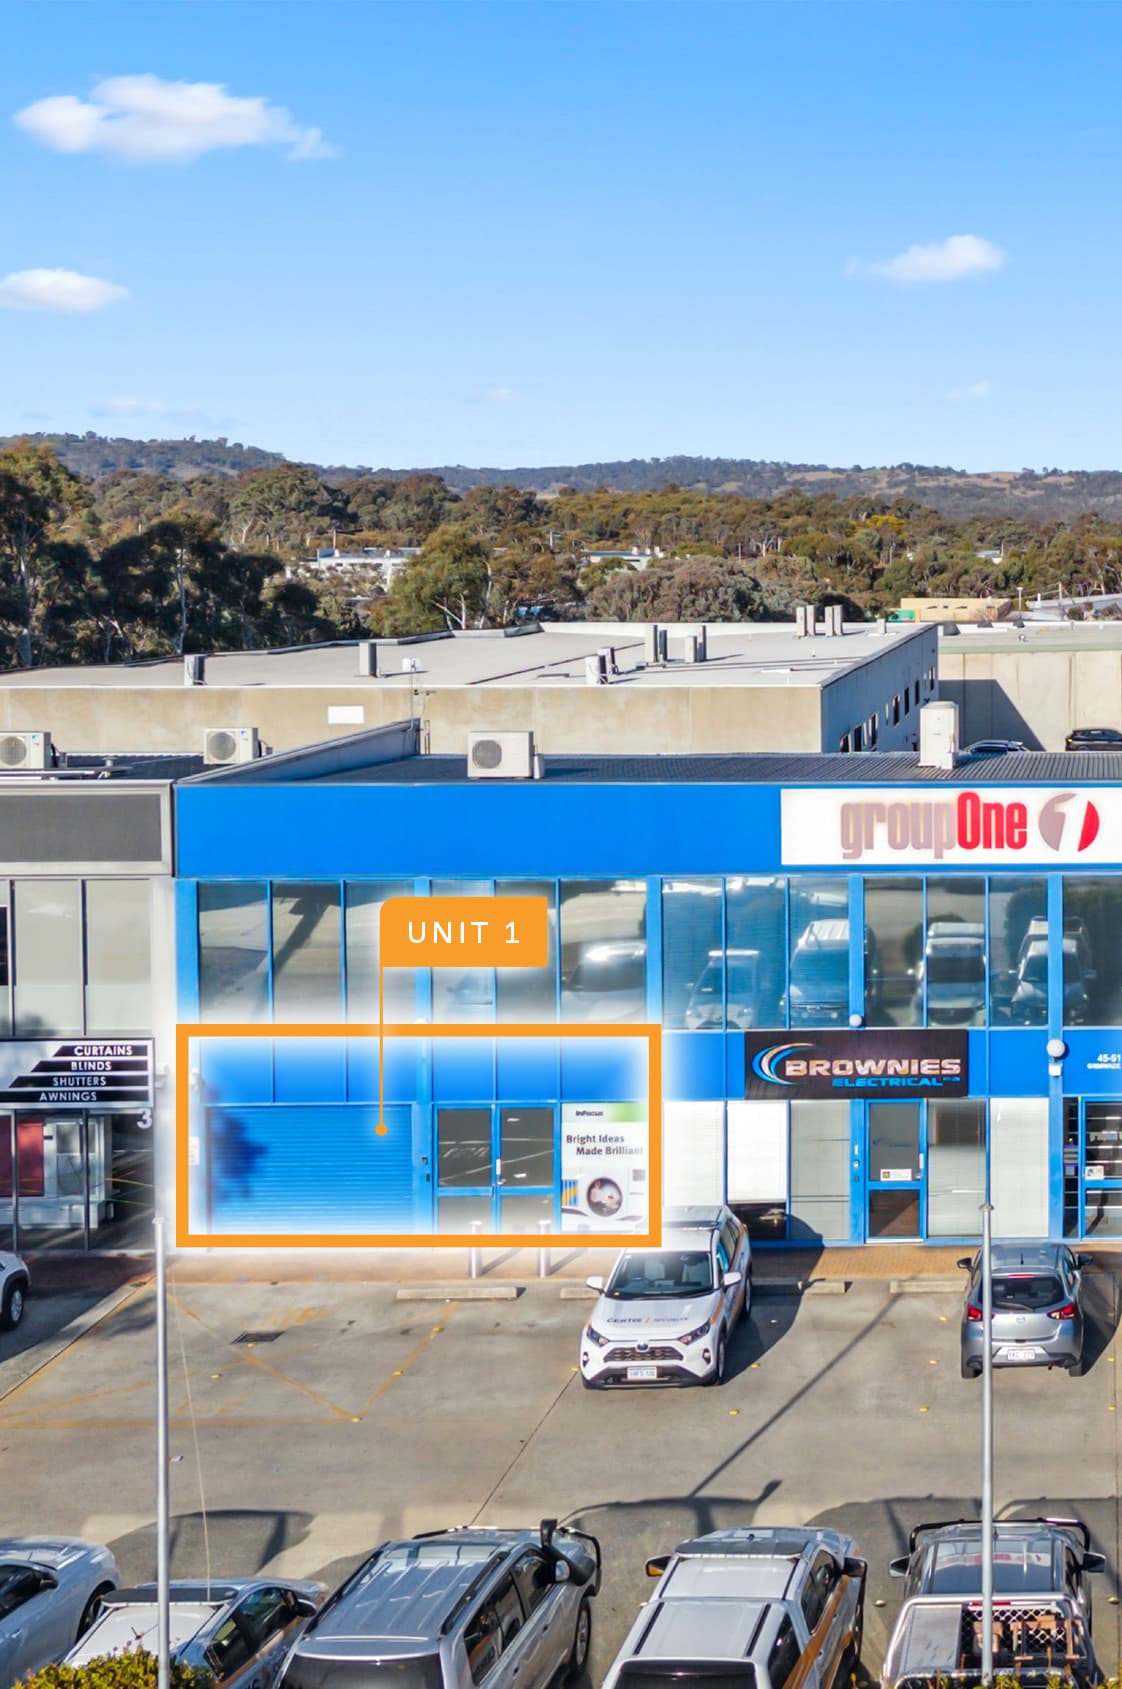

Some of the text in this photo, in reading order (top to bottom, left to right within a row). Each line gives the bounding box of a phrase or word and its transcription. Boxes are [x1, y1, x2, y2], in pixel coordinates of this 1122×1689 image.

[840, 791, 1028, 860] groupOne
[74, 1045, 133, 1056] CURTAINS
[71, 1061, 112, 1071] BLINDS
[785, 1058, 961, 1077] BROWNIES
[52, 1076, 107, 1087] SHUTTERS
[832, 1077, 944, 1088] ELECTRICAL
[39, 1091, 97, 1101] AWNINGS
[136, 1108, 153, 1129] 3
[566, 1135, 625, 1145] Bright Ideas
[576, 1146, 603, 1156] Made
